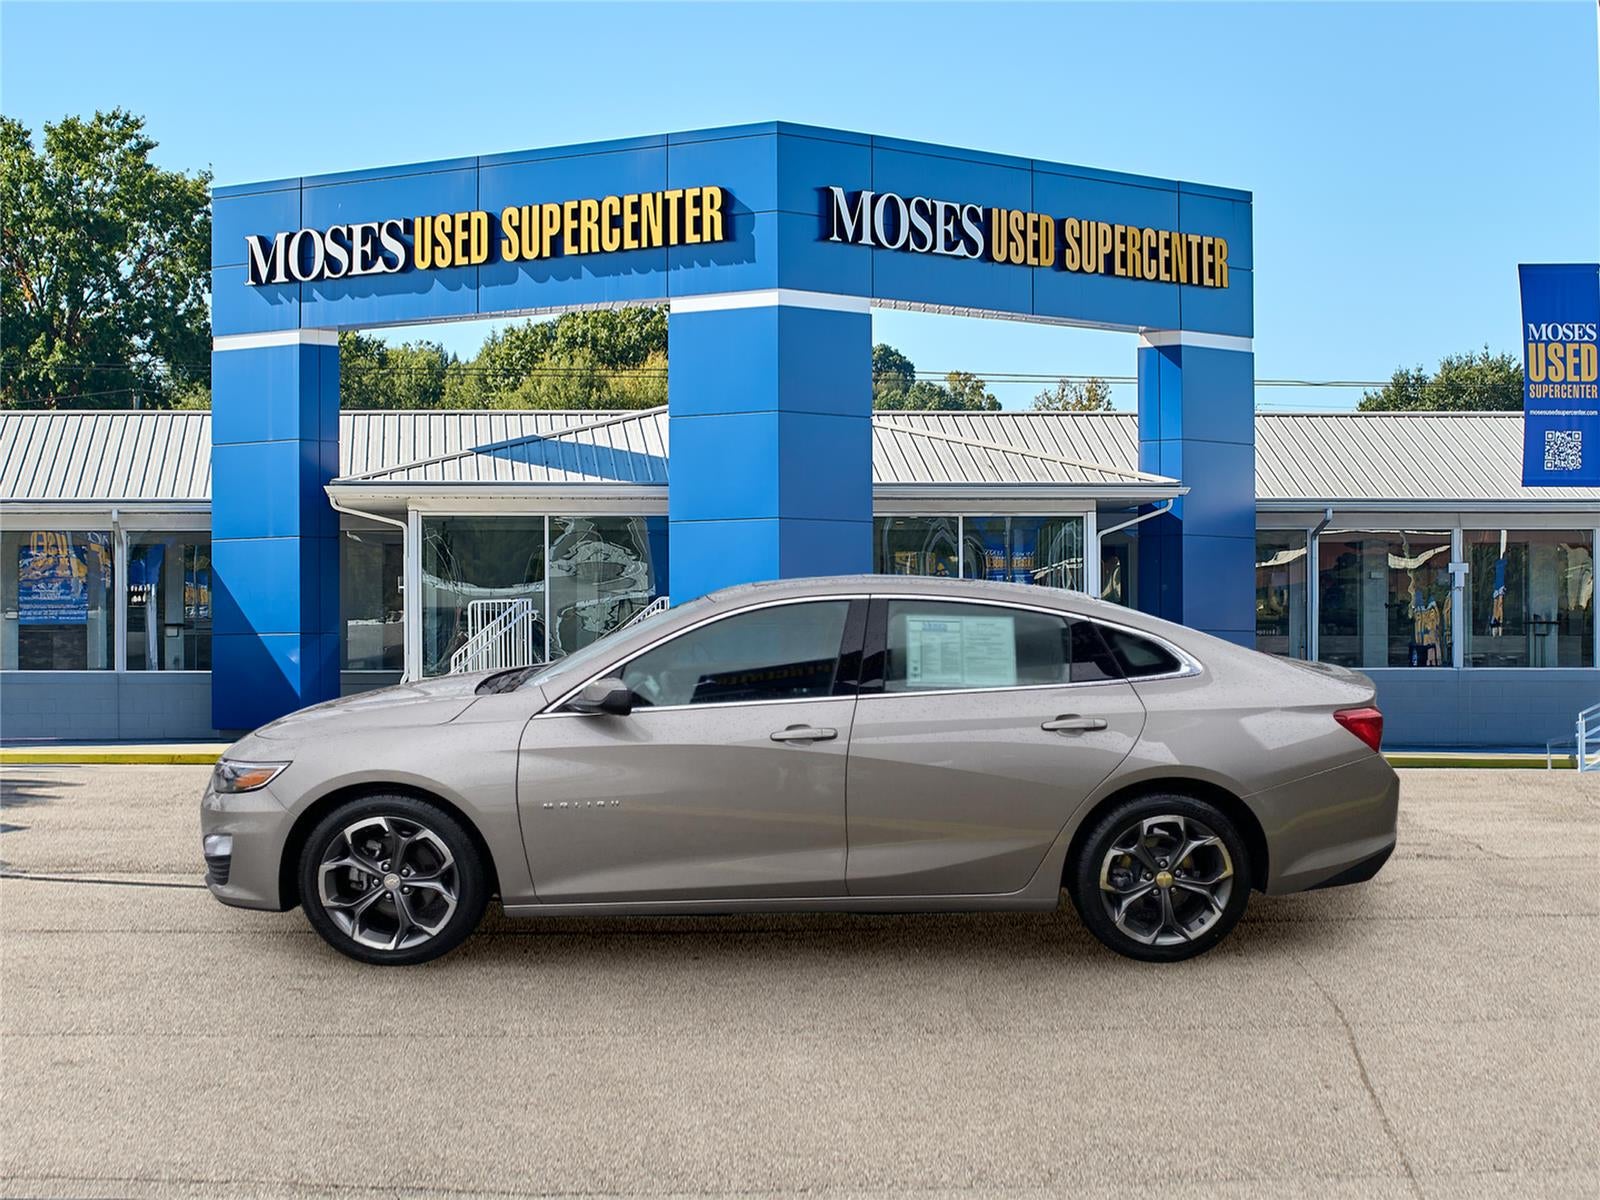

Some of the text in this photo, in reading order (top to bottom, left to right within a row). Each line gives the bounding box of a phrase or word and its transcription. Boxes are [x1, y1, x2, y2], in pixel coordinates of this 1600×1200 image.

[244, 186, 723, 286] MOSES USED SUPERCENTER
[828, 186, 1229, 288] MOSES USED SUPERCENTER
[1528, 323, 1597, 341] MOSES
[1528, 343, 1597, 382] USED
[1530, 384, 1598, 397] SUPERCENTER
